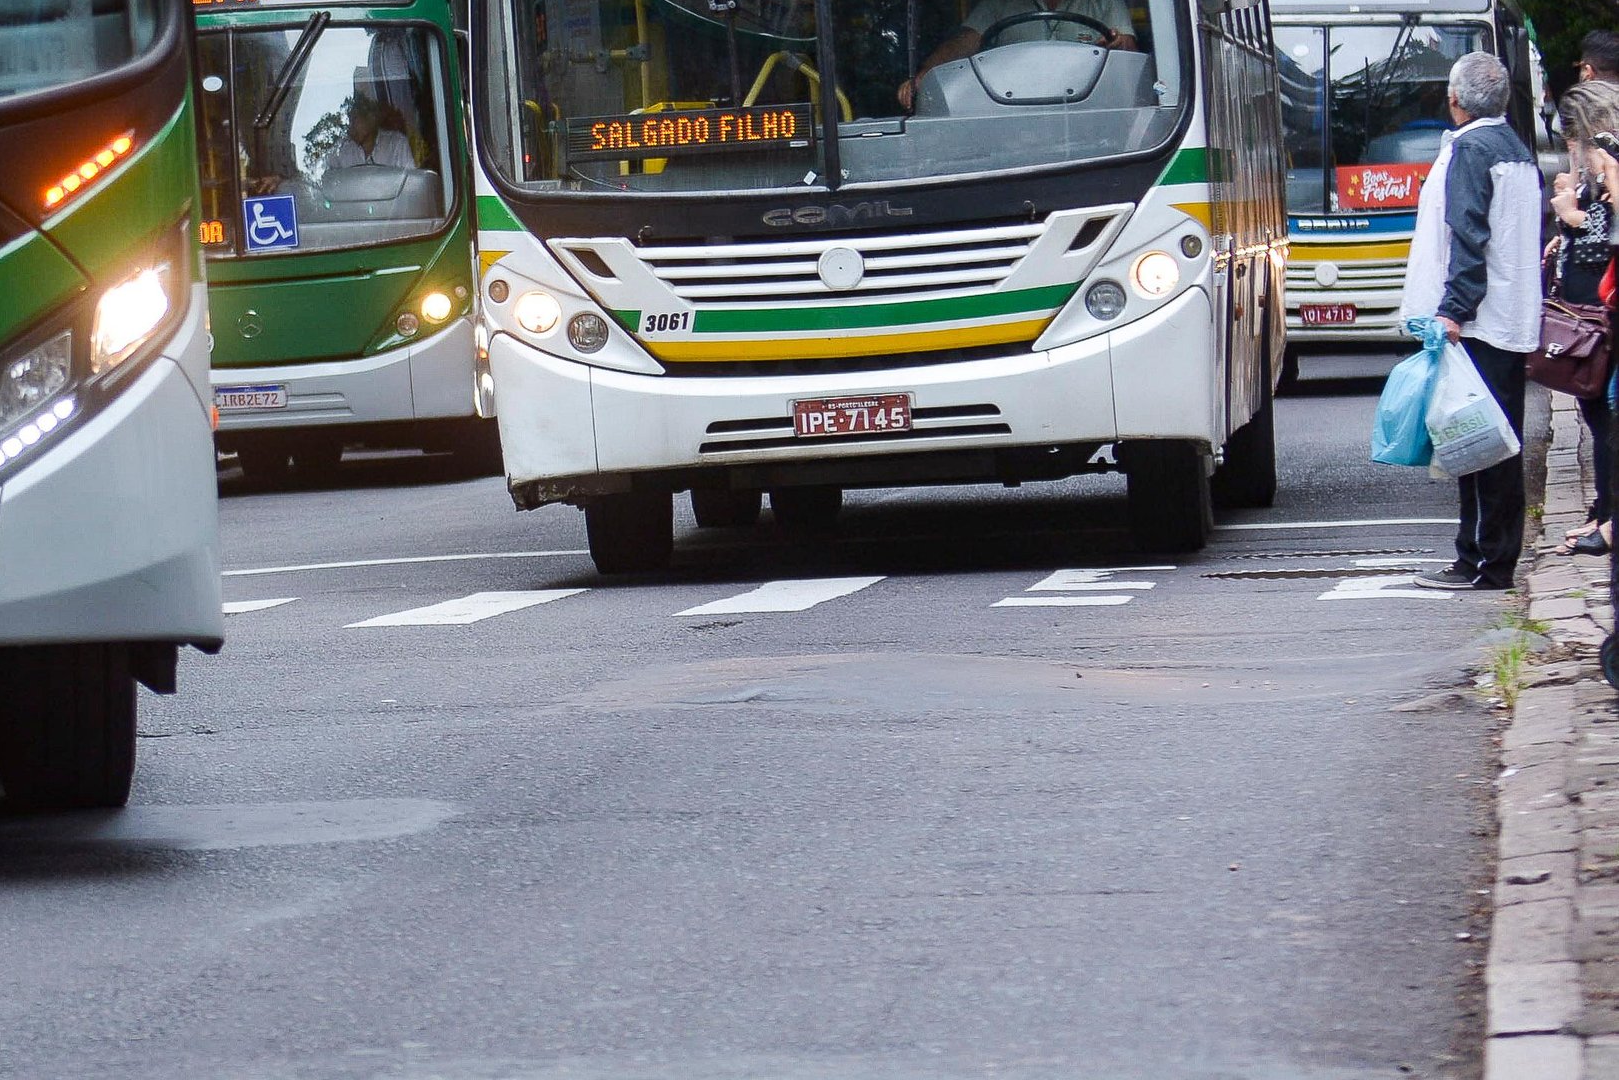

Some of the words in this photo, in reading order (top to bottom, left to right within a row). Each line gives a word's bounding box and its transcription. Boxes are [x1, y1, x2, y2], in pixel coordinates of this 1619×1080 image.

[590, 116, 709, 151] SALGADO
[719, 110, 795, 142] FILHO
[645, 312, 689, 332] 3061
